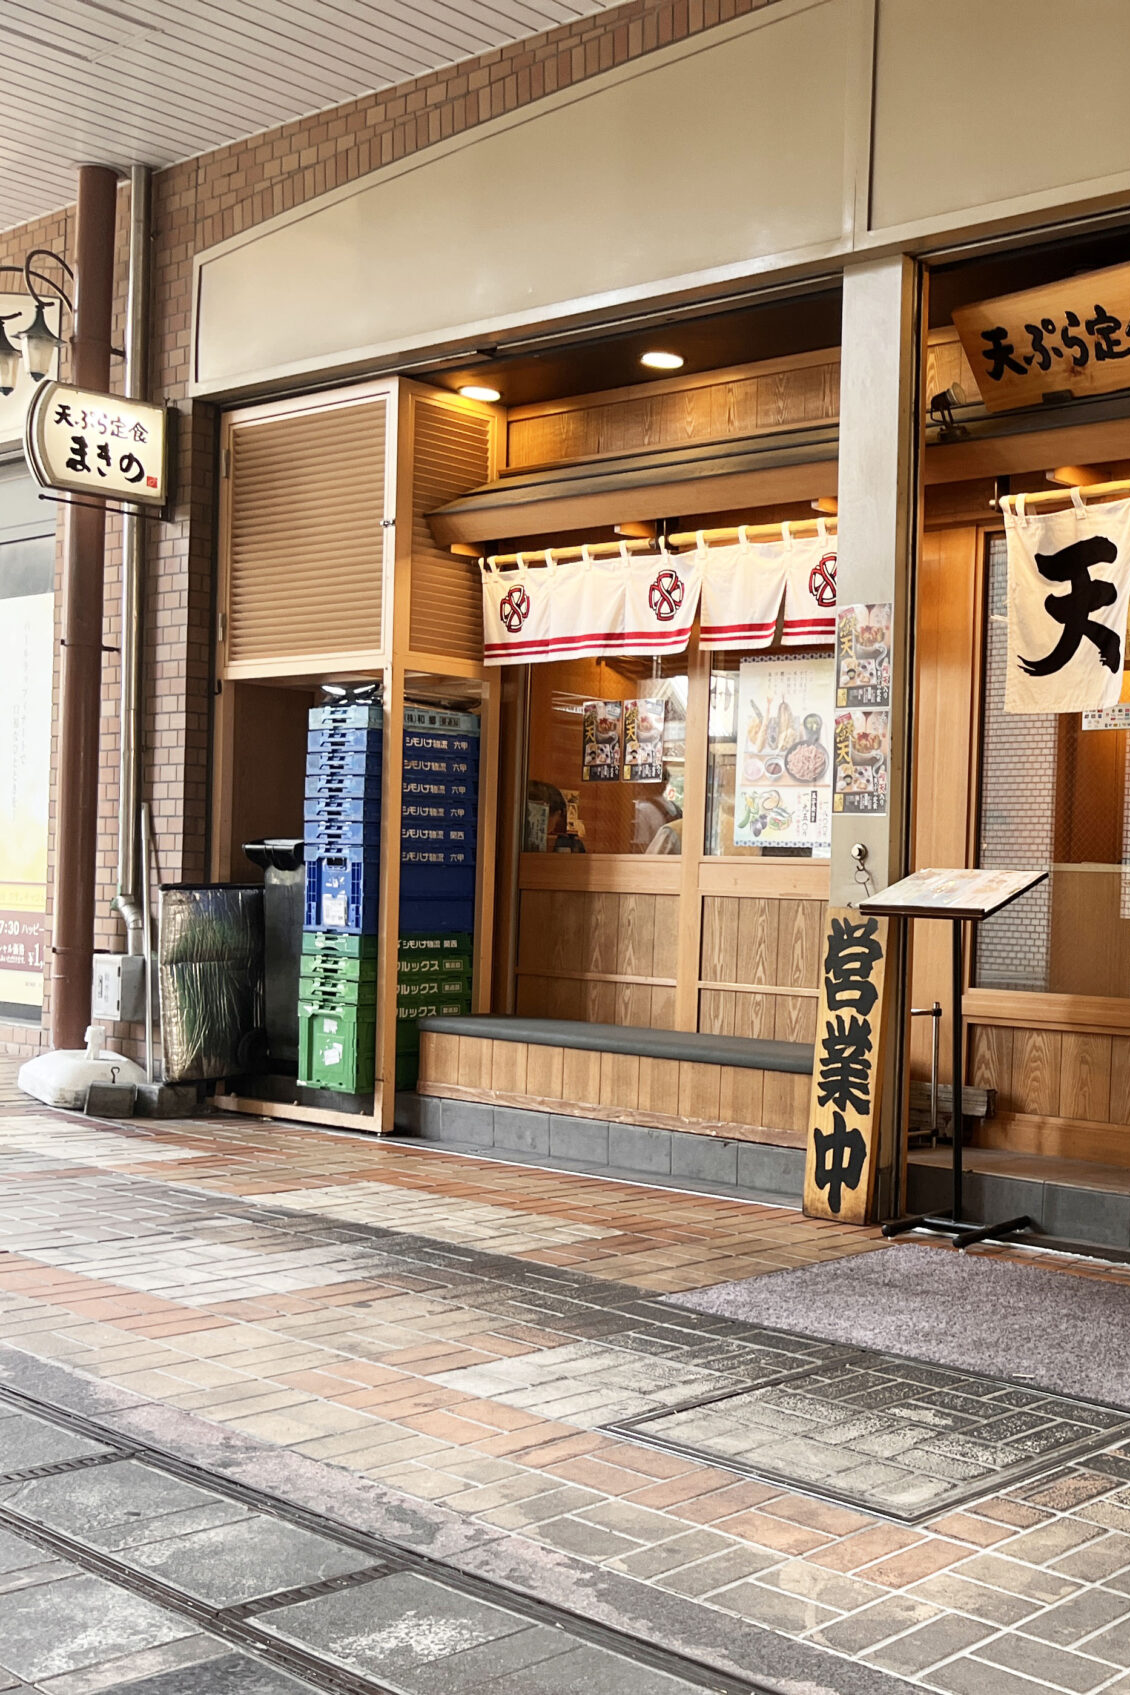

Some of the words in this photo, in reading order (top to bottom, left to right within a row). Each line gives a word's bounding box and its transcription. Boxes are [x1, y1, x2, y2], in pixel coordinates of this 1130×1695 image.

[54, 404, 148, 443] 天ぷら定食
[66, 436, 145, 483] まきの
[814, 917, 884, 1213] 営業中
